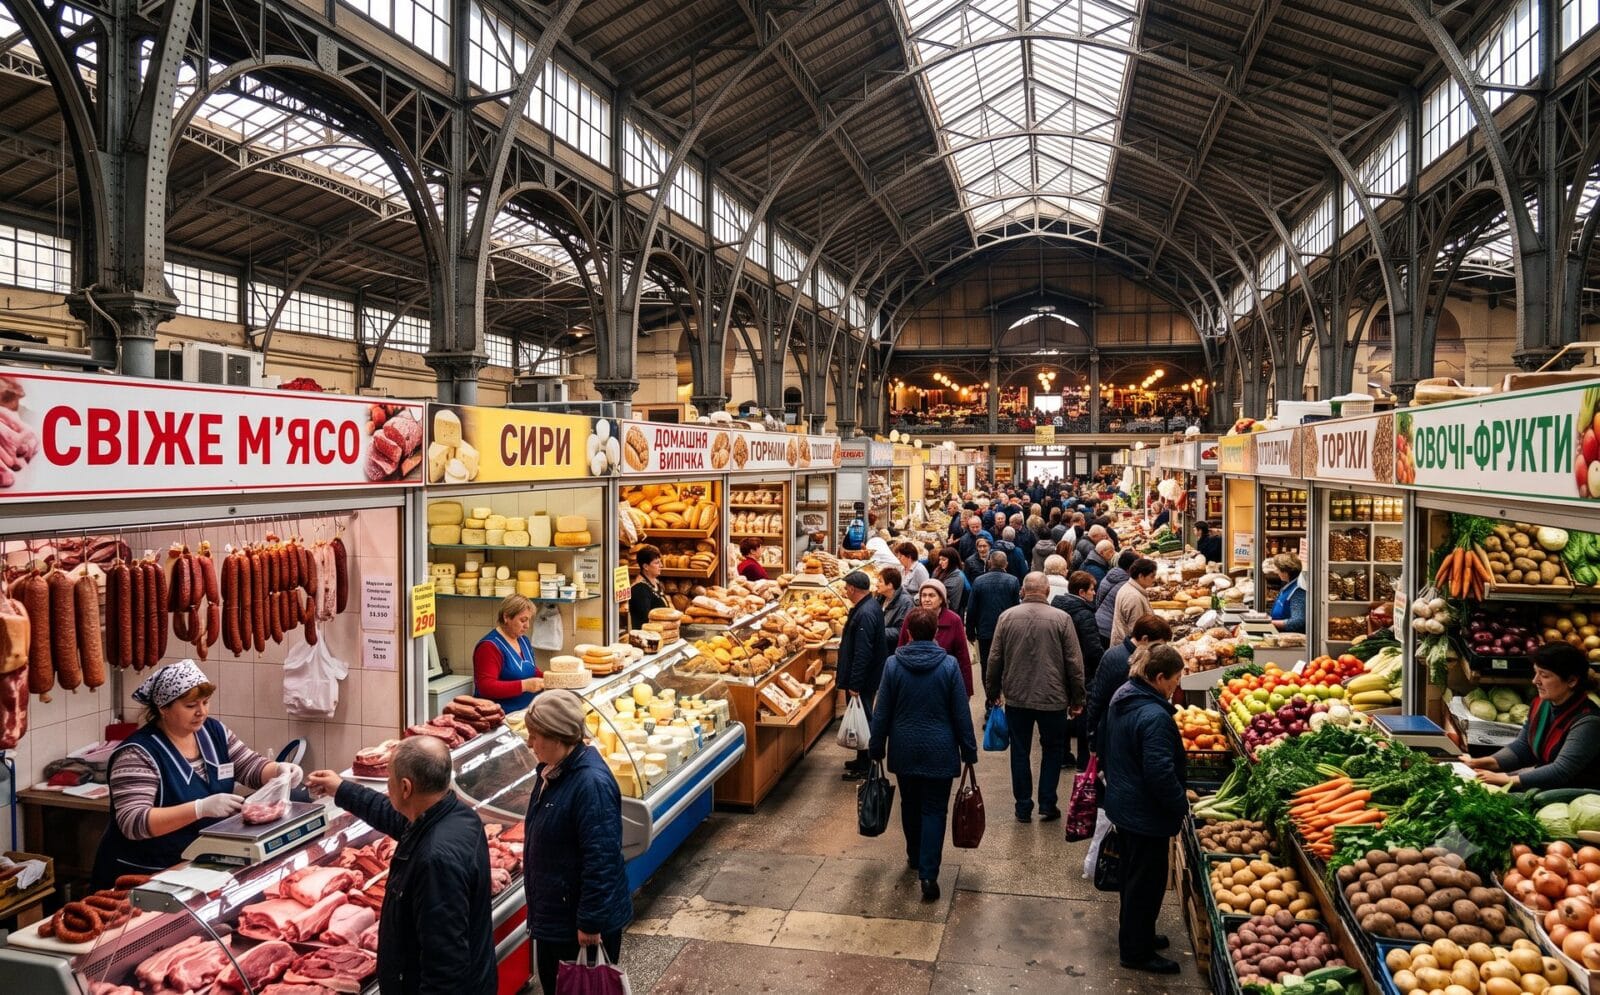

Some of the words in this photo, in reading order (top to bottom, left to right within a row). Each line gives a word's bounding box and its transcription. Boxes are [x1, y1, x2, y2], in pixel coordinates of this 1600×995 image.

[42, 405, 224, 466] СВІЖЕ
[238, 415, 361, 466] М’ЯСО
[500, 423, 571, 467] СИРИ
[654, 428, 708, 451] ДОМАШНЯ
[1322, 430, 1368, 469] ГОРІХИ
[1415, 413, 1573, 474] ОВОЧІ-ФРУКТИ
[659, 451, 704, 470] ВИПІЧКА
[414, 612, 435, 632] 290
